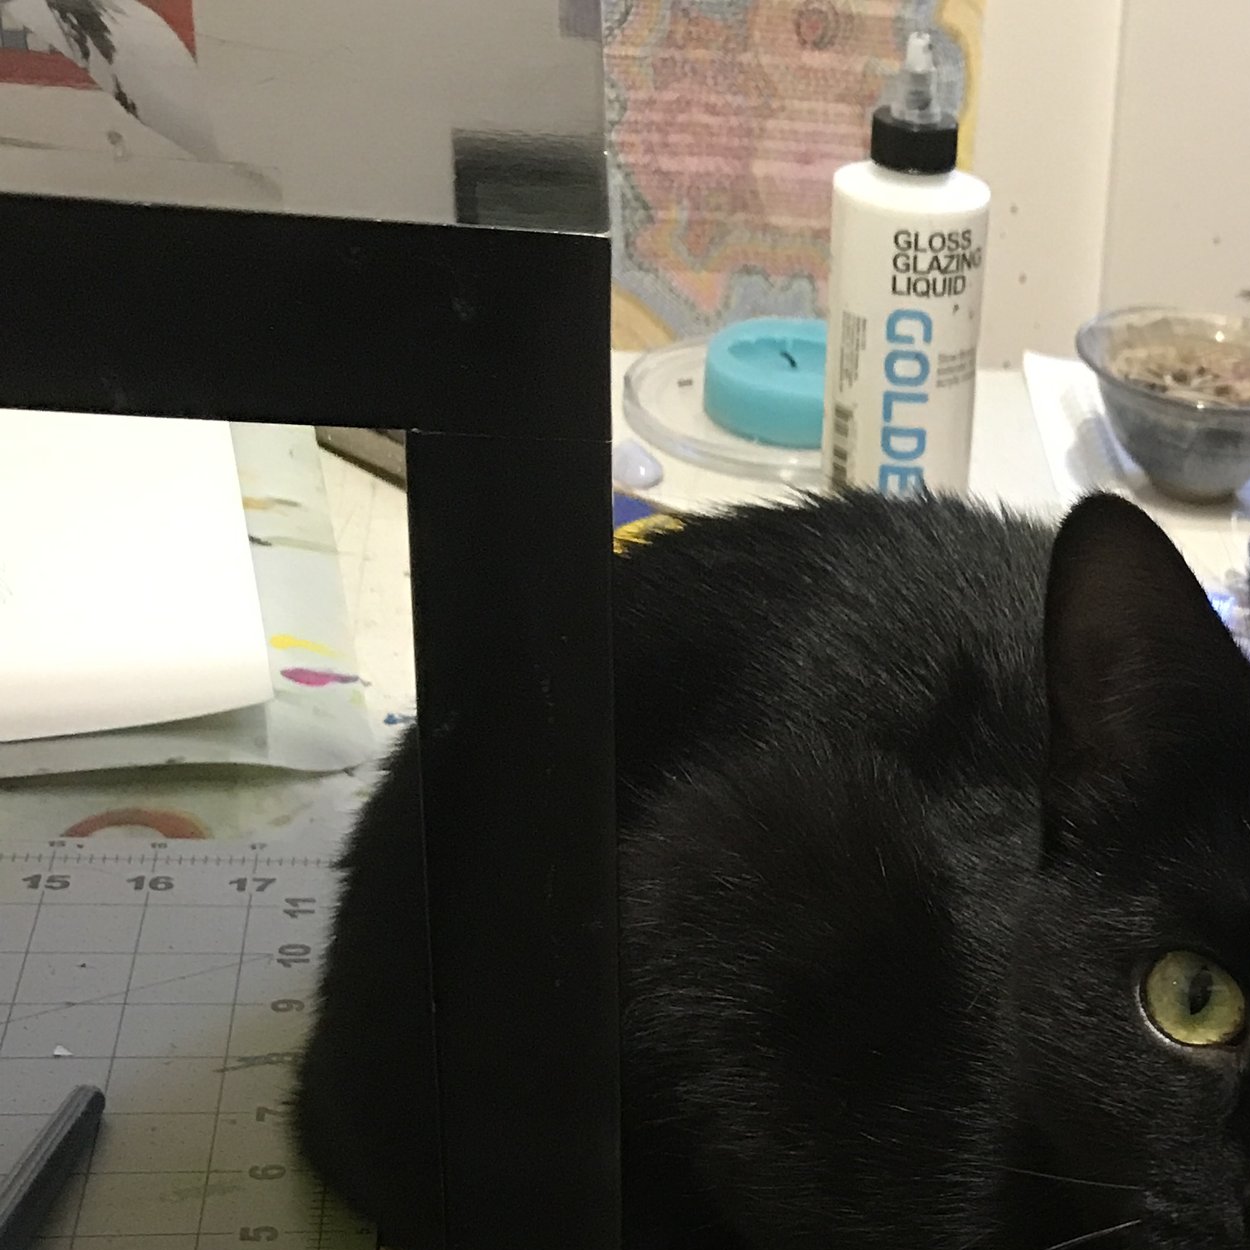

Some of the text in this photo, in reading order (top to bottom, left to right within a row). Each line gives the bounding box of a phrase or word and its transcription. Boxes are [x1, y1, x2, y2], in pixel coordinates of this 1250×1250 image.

[894, 230, 972, 253] GLOSS
[893, 249, 982, 275] GLAZING
[892, 275, 967, 298] LIQUID
[879, 309, 933, 497] GOLDE
[21, 874, 277, 892] 15 16 17
[283, 897, 316, 919] 11
[276, 943, 311, 968] 10
[248, 1164, 287, 1180] 6
[239, 1226, 279, 1243] 5
